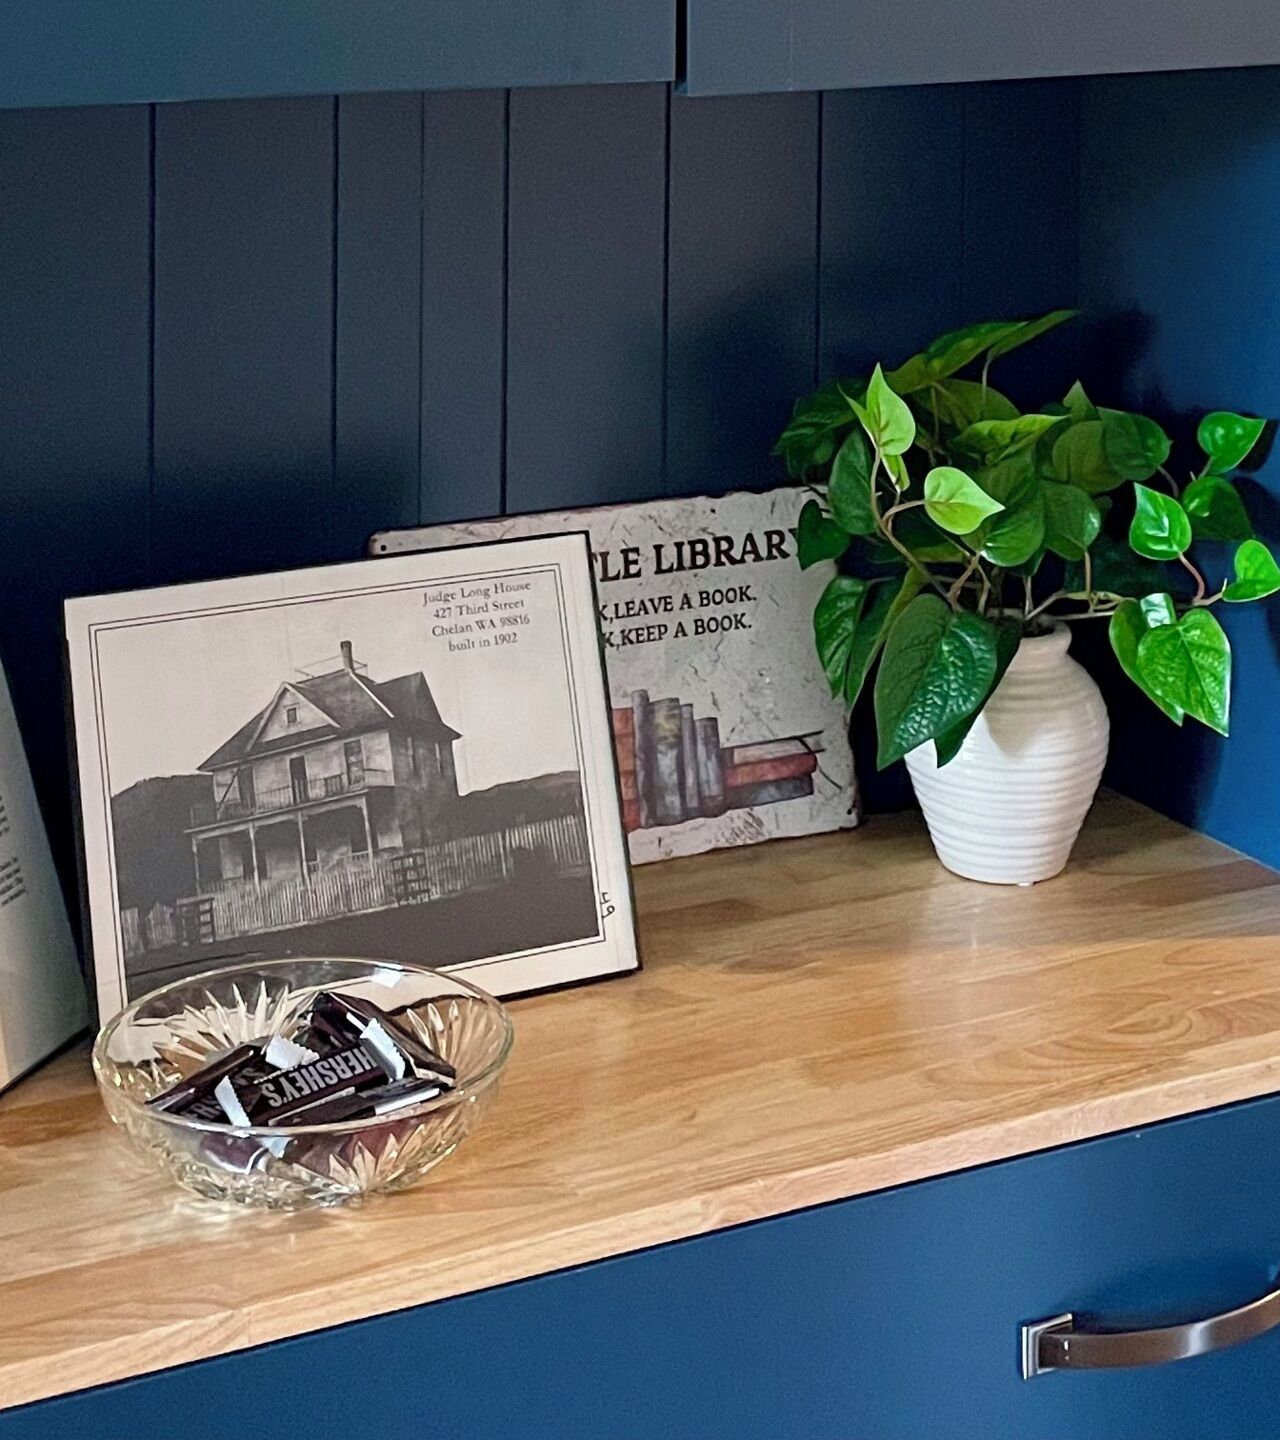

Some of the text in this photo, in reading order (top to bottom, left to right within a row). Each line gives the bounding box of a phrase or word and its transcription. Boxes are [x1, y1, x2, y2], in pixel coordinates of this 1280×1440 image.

[422, 581, 532, 607] Judge Long House
[679, 593, 695, 610] A
[698, 585, 758, 608] BOOK.
[433, 599, 525, 619] 427 Third Street
[431, 614, 531, 637] Chelan WA 98816
[673, 621, 689, 639] A
[693, 612, 753, 636] BOOK.
[448, 631, 518, 652] built in 1902
[260, 1044, 380, 1109] HERSHEY'S
